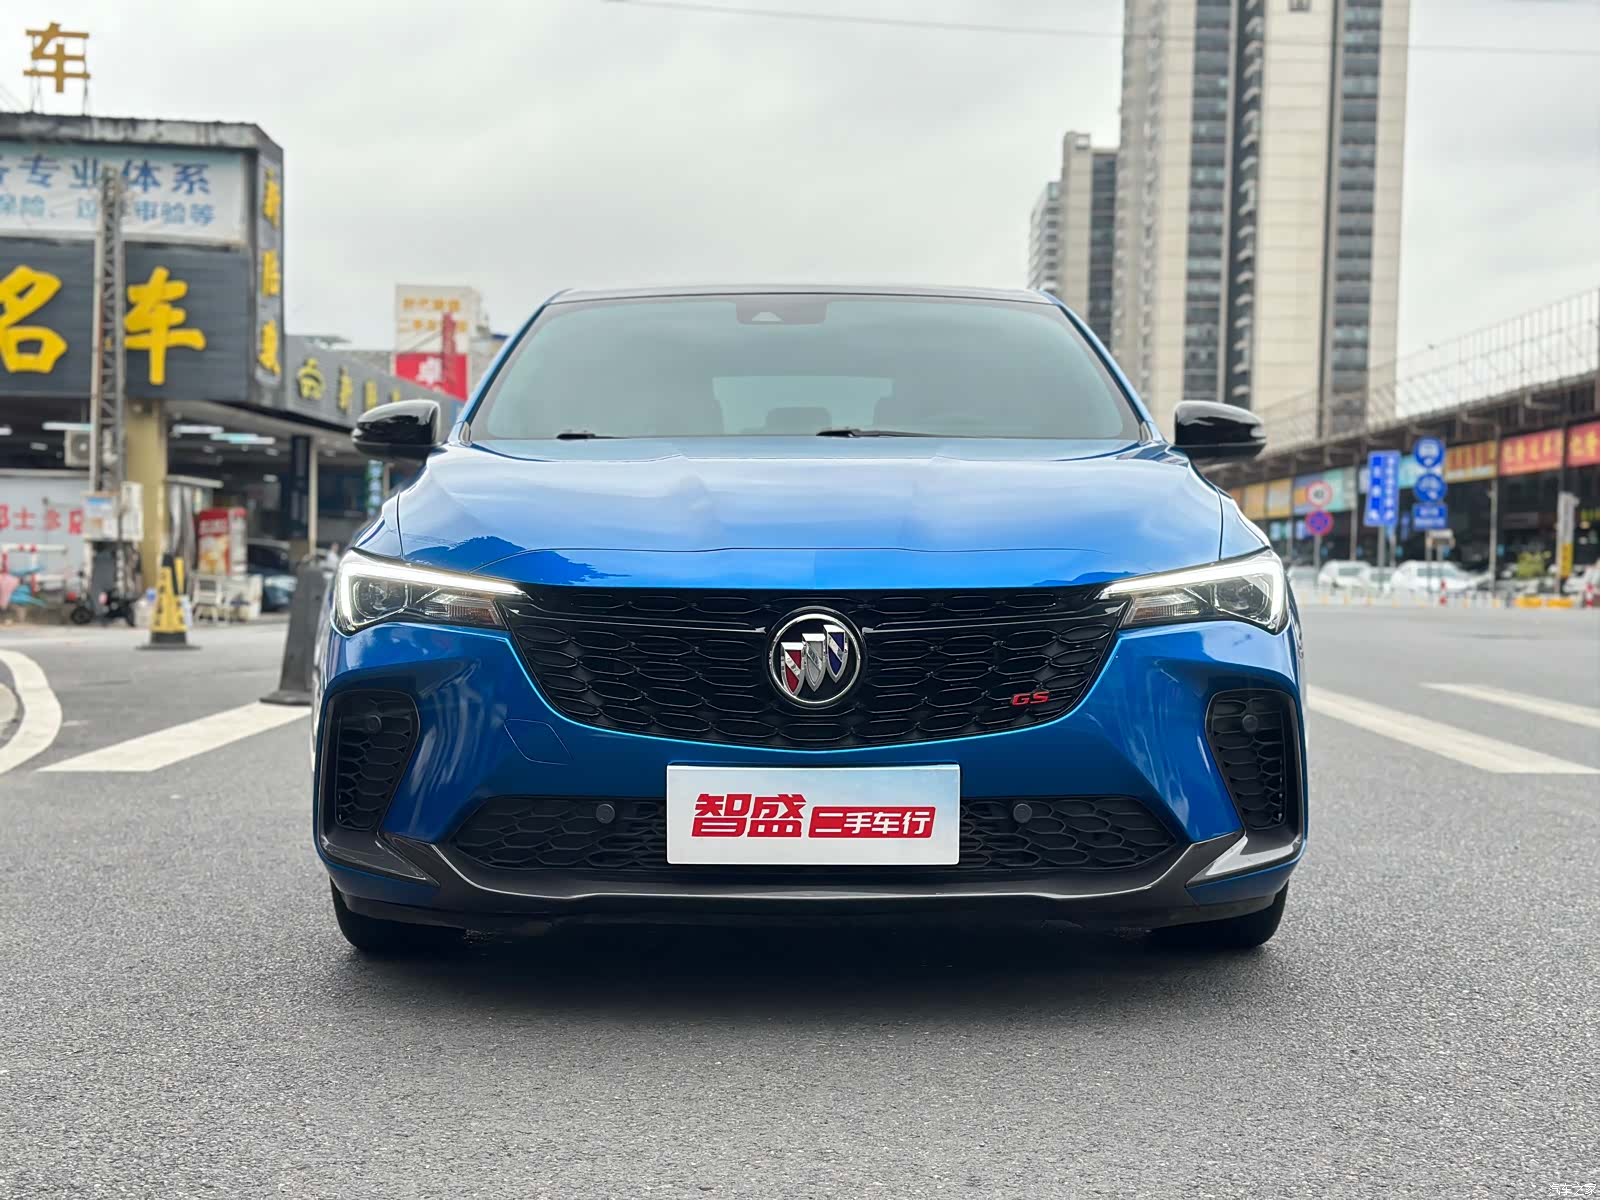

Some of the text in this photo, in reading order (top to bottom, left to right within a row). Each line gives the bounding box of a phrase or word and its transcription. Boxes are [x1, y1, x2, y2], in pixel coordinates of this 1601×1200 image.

[24, 22, 90, 93] 车
[0, 153, 211, 195] 专业体系
[0, 265, 206, 385] 名车
[1011, 690, 1050, 706] GS
[691, 793, 934, 838] 智盛 二手车行
